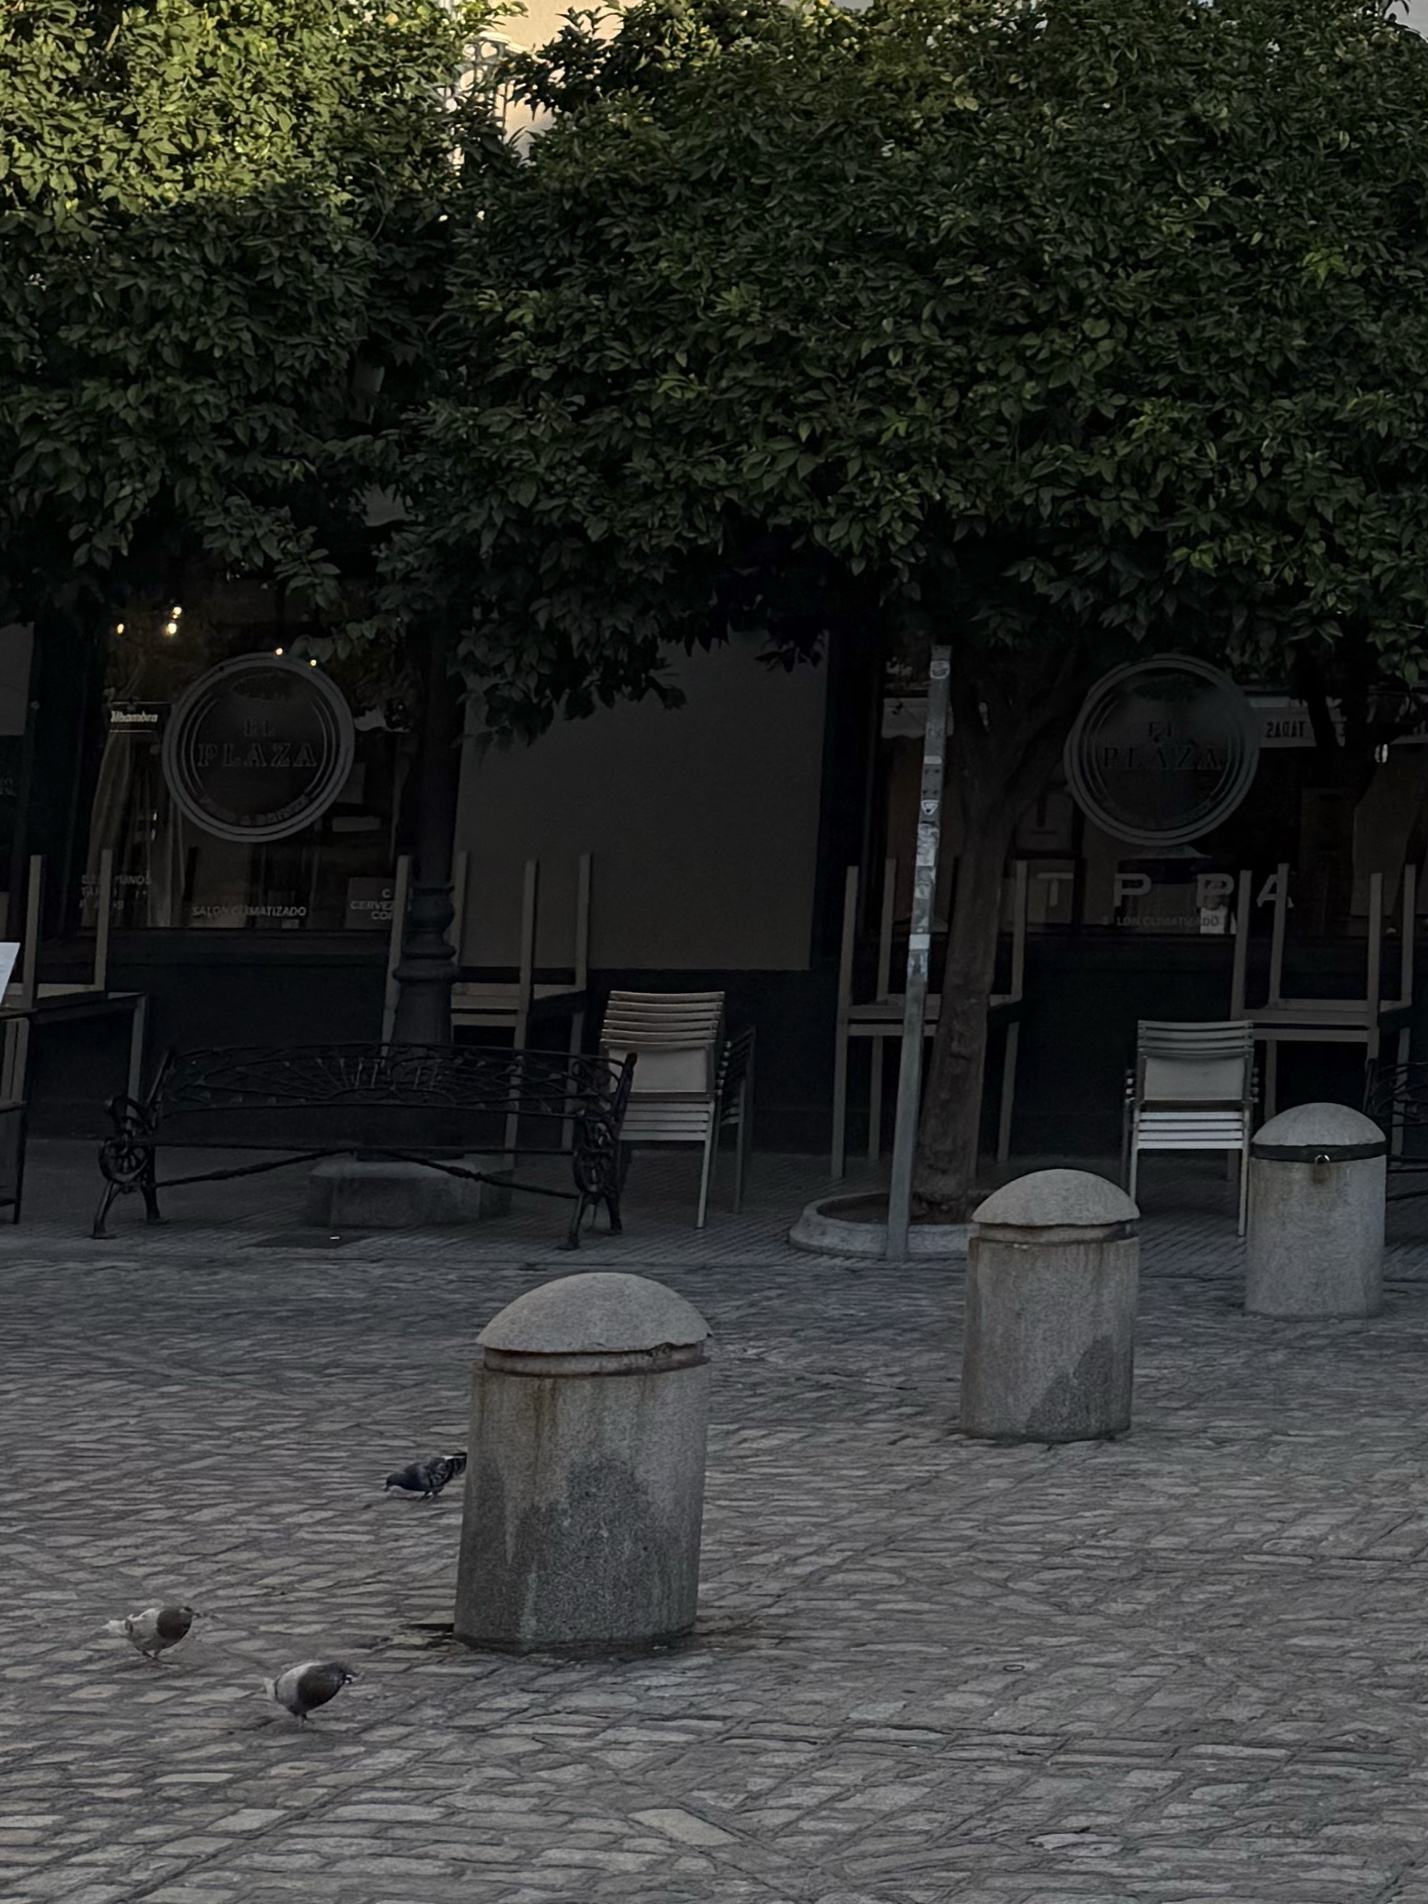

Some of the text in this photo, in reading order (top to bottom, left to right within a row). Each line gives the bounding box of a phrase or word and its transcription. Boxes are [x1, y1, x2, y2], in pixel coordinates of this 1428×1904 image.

[197, 741, 319, 769] PLAZA
[1103, 746, 1223, 771] PLAZA
[231, 905, 308, 917] CLIMATIZADO
